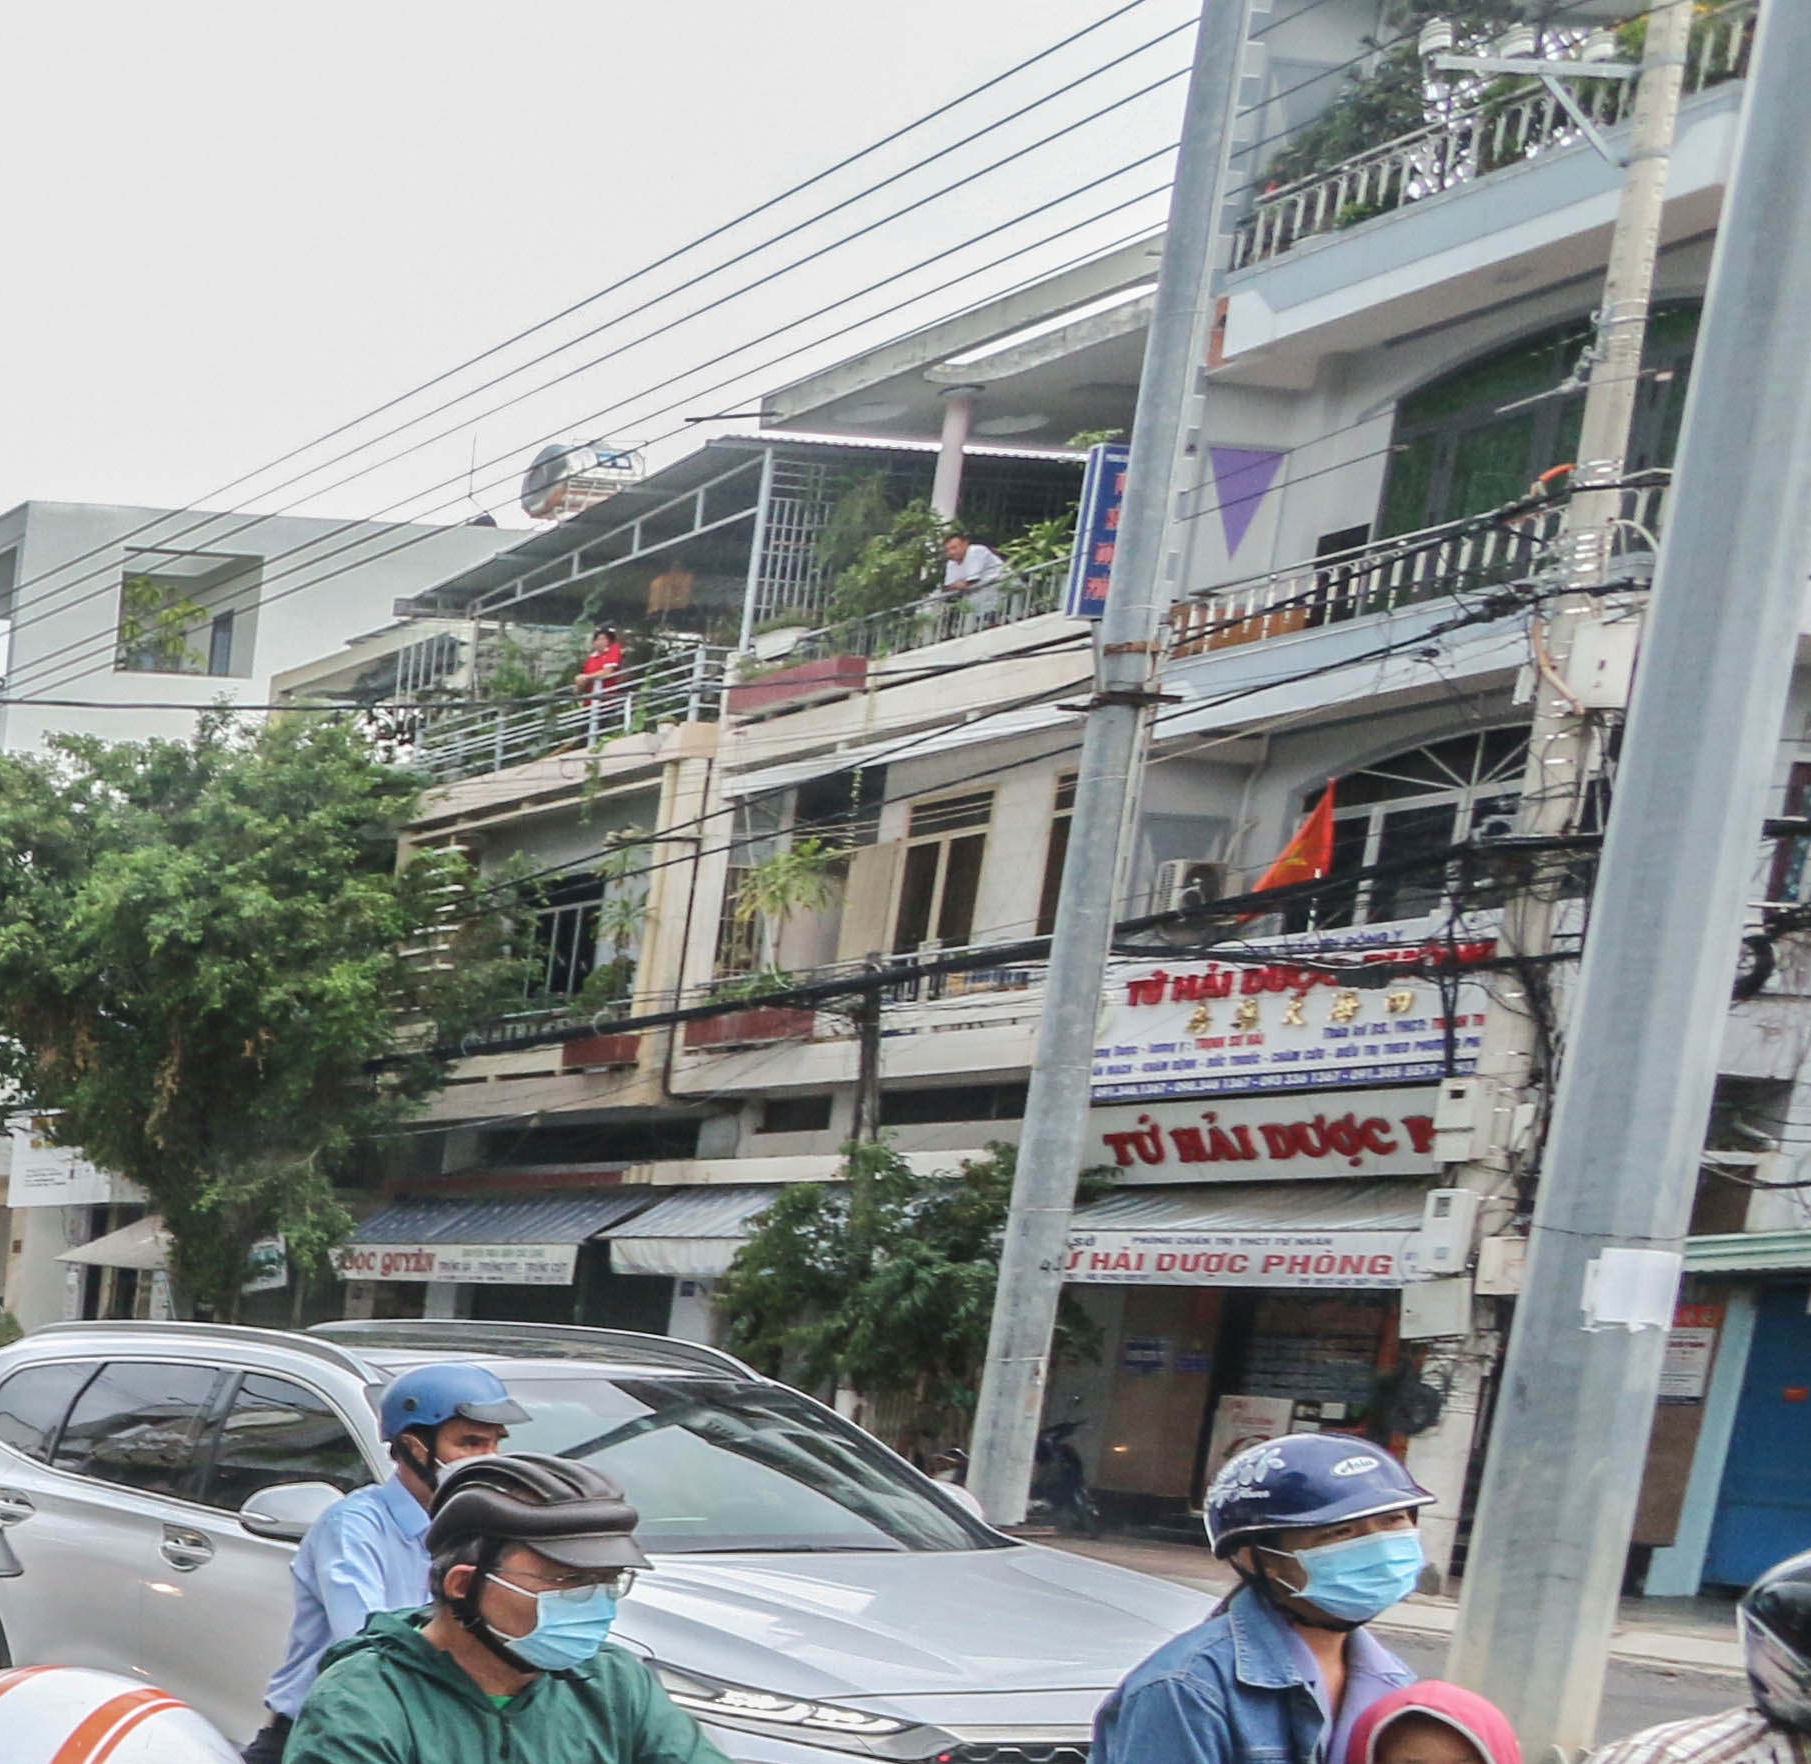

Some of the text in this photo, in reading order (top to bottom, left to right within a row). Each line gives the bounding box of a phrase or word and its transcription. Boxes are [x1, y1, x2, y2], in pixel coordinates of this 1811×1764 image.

[1168, 1110, 1259, 1163] HẢI
[1258, 1112, 1398, 1168] DƯỢC
[1089, 1246, 1146, 1272] HẢI
[1155, 1251, 1250, 1277] DƯỢC
[1260, 1248, 1393, 1276] PHÒNG
